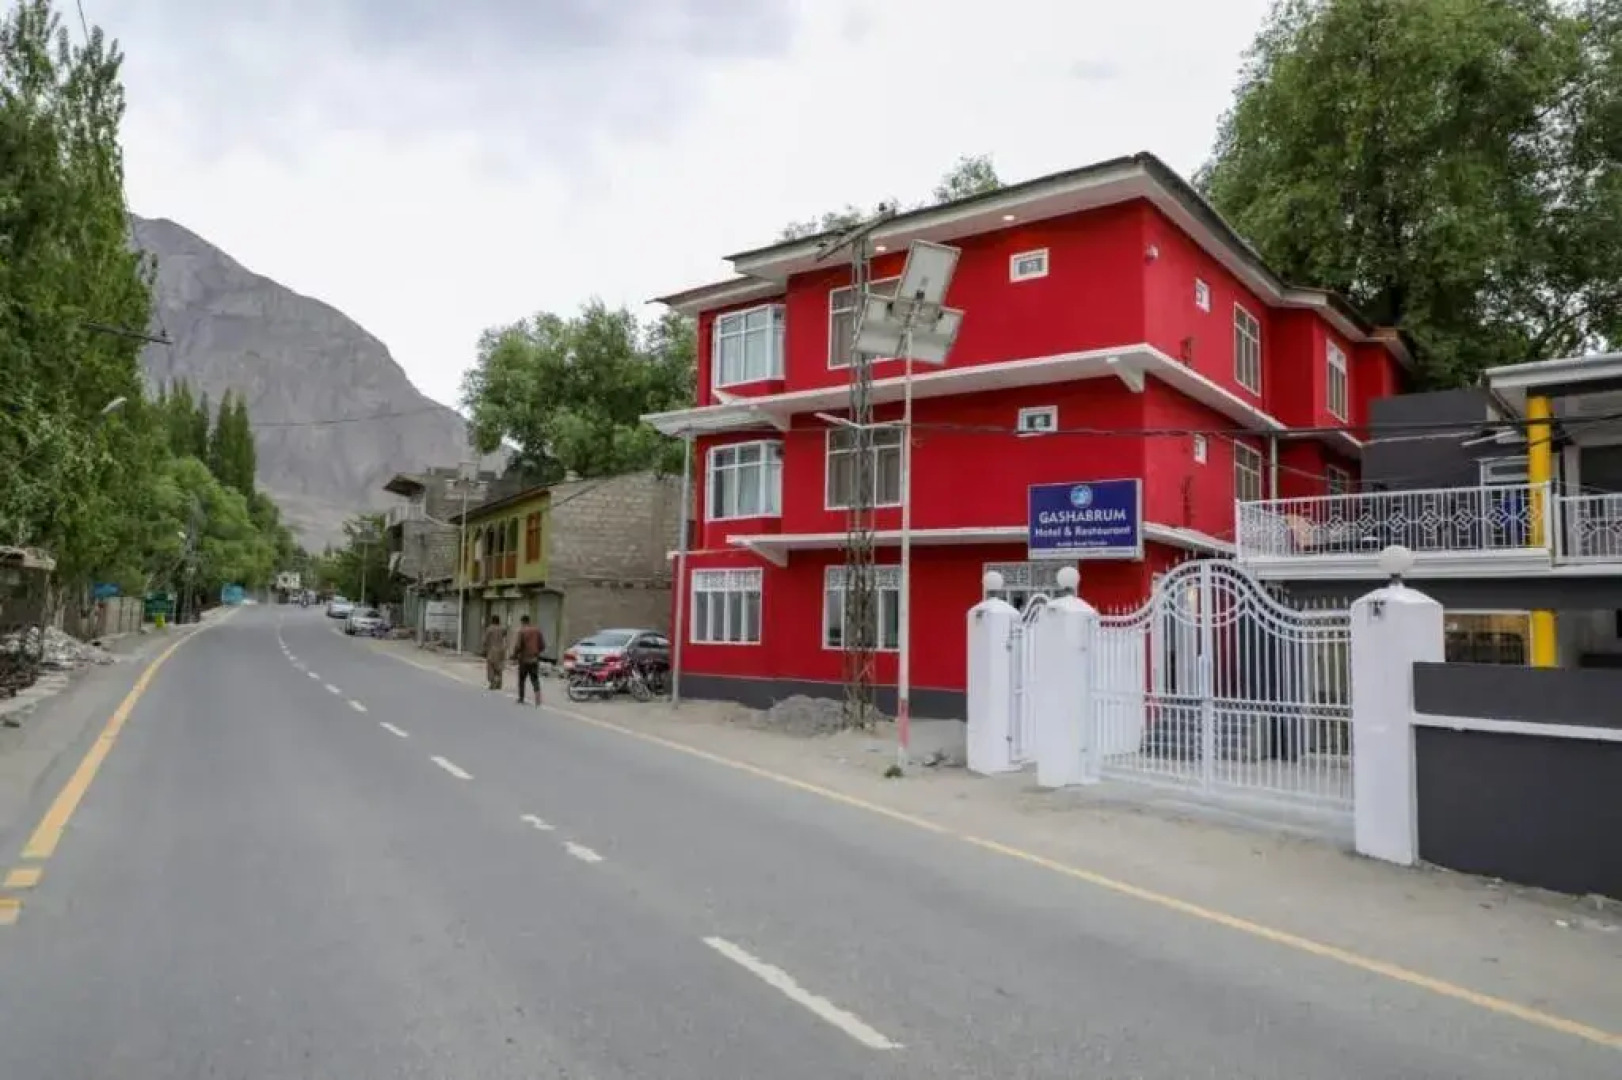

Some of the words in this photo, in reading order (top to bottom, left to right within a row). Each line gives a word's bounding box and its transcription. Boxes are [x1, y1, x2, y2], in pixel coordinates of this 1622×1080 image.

[1039, 509, 1126, 523] GASHABRUM
[1035, 527, 1061, 536] Hotel
[1064, 526, 1072, 536] &
